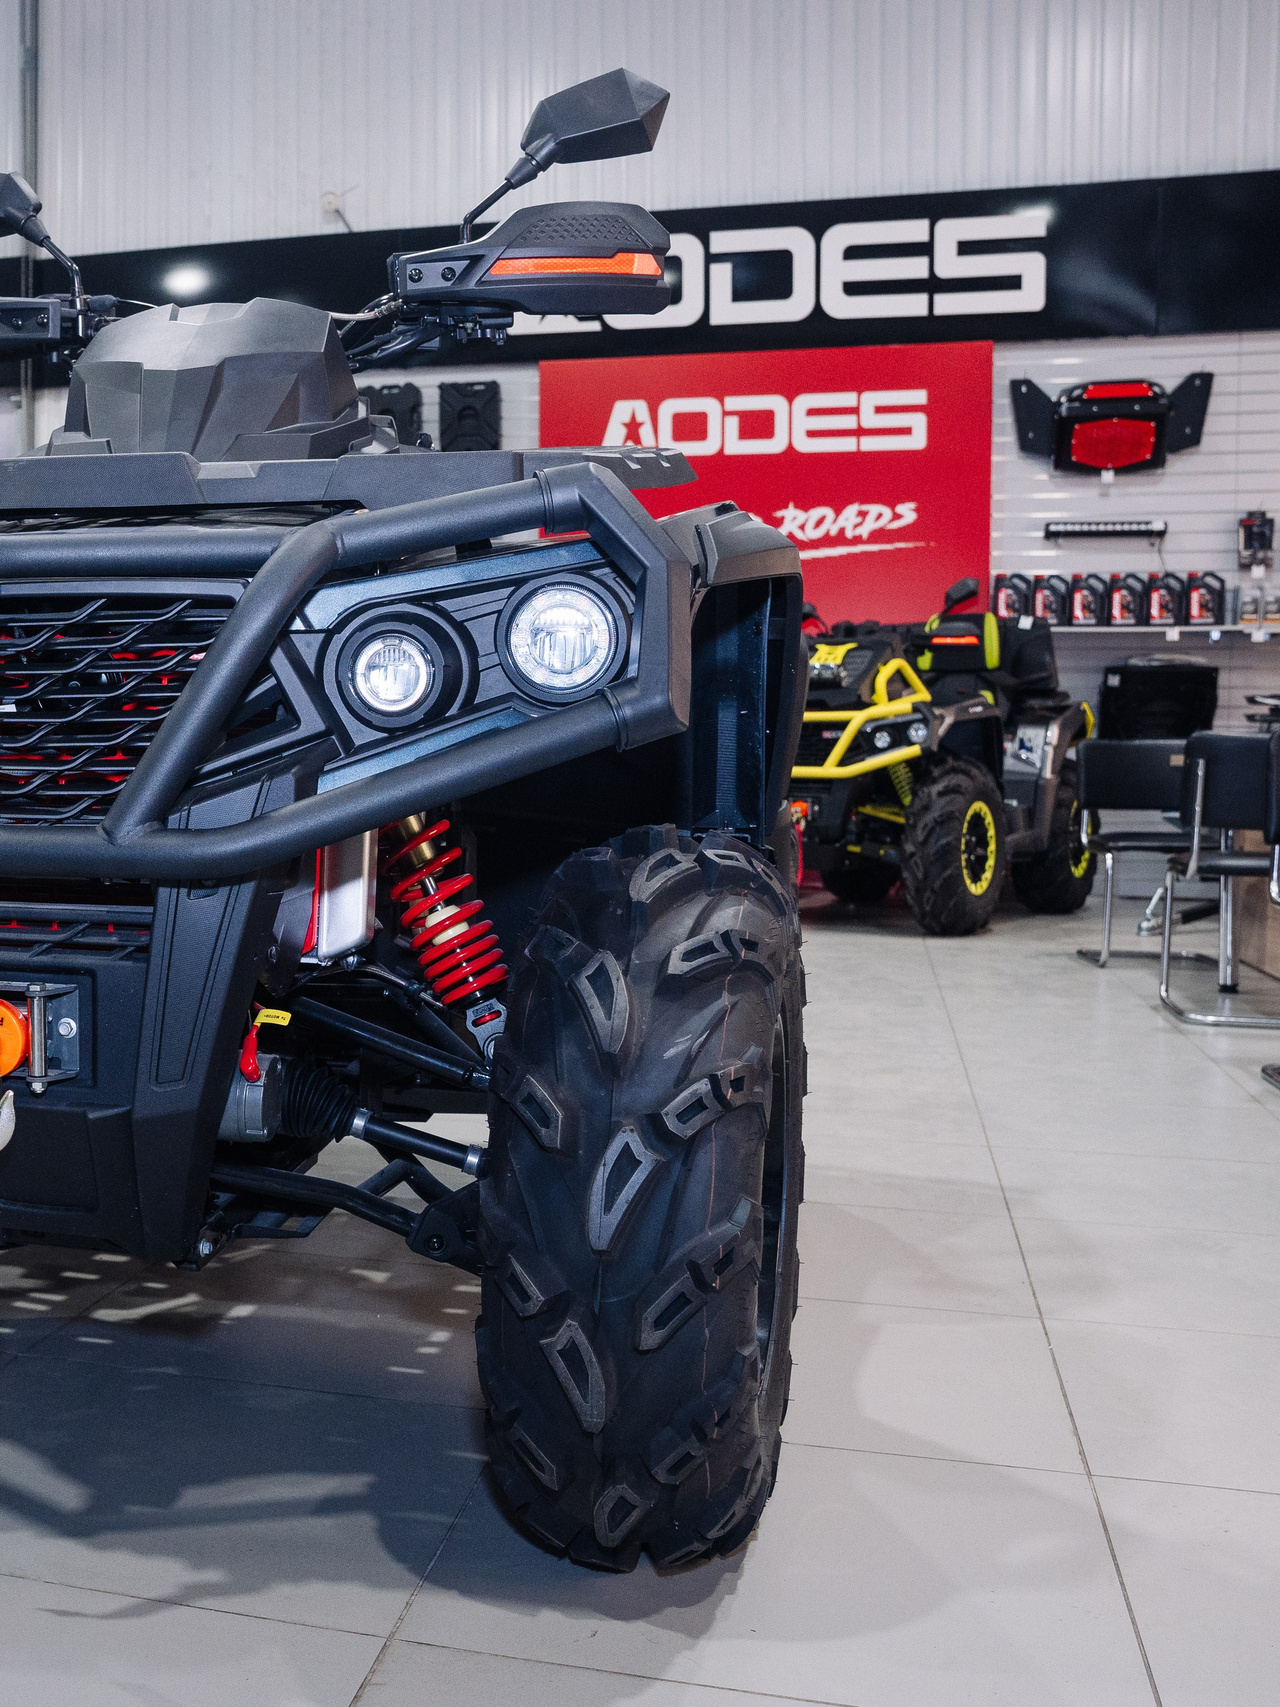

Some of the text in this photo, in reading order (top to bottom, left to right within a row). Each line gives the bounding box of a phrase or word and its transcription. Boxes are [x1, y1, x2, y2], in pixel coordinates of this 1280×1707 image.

[507, 212, 1048, 336] ODES
[602, 389, 928, 456] AODES
[773, 501, 919, 541] ROADS
